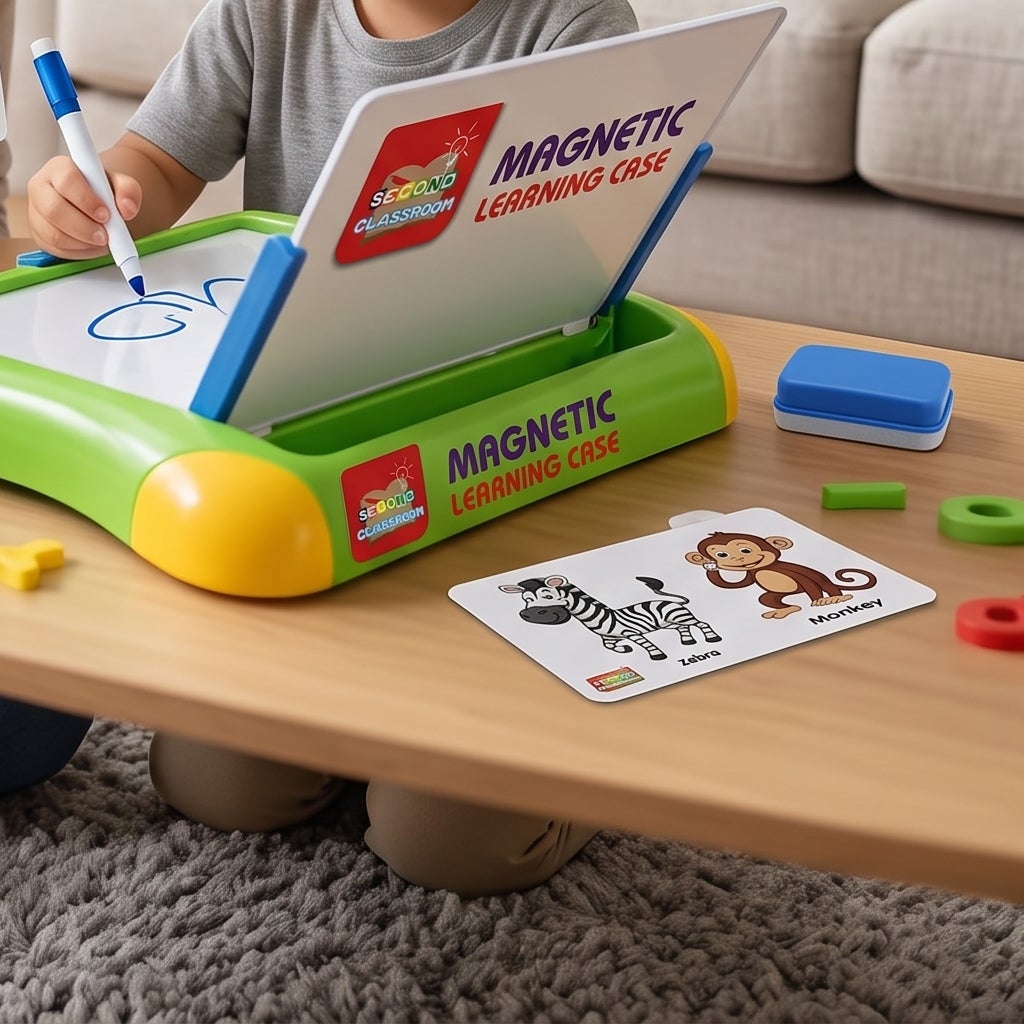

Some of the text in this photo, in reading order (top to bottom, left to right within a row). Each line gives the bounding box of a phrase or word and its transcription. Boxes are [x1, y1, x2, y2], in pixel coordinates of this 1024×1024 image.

[489, 99, 696, 186] MAGNETIC
[370, 172, 457, 209] SECOND
[473, 147, 672, 224] LEARNING CASE
[353, 196, 456, 234] CLASSROOM
[448, 389, 616, 484] MAGNETIC
[451, 429, 621, 517] LEARNING CASE
[808, 598, 883, 625] Monkey
[677, 650, 721, 667] Zebra
